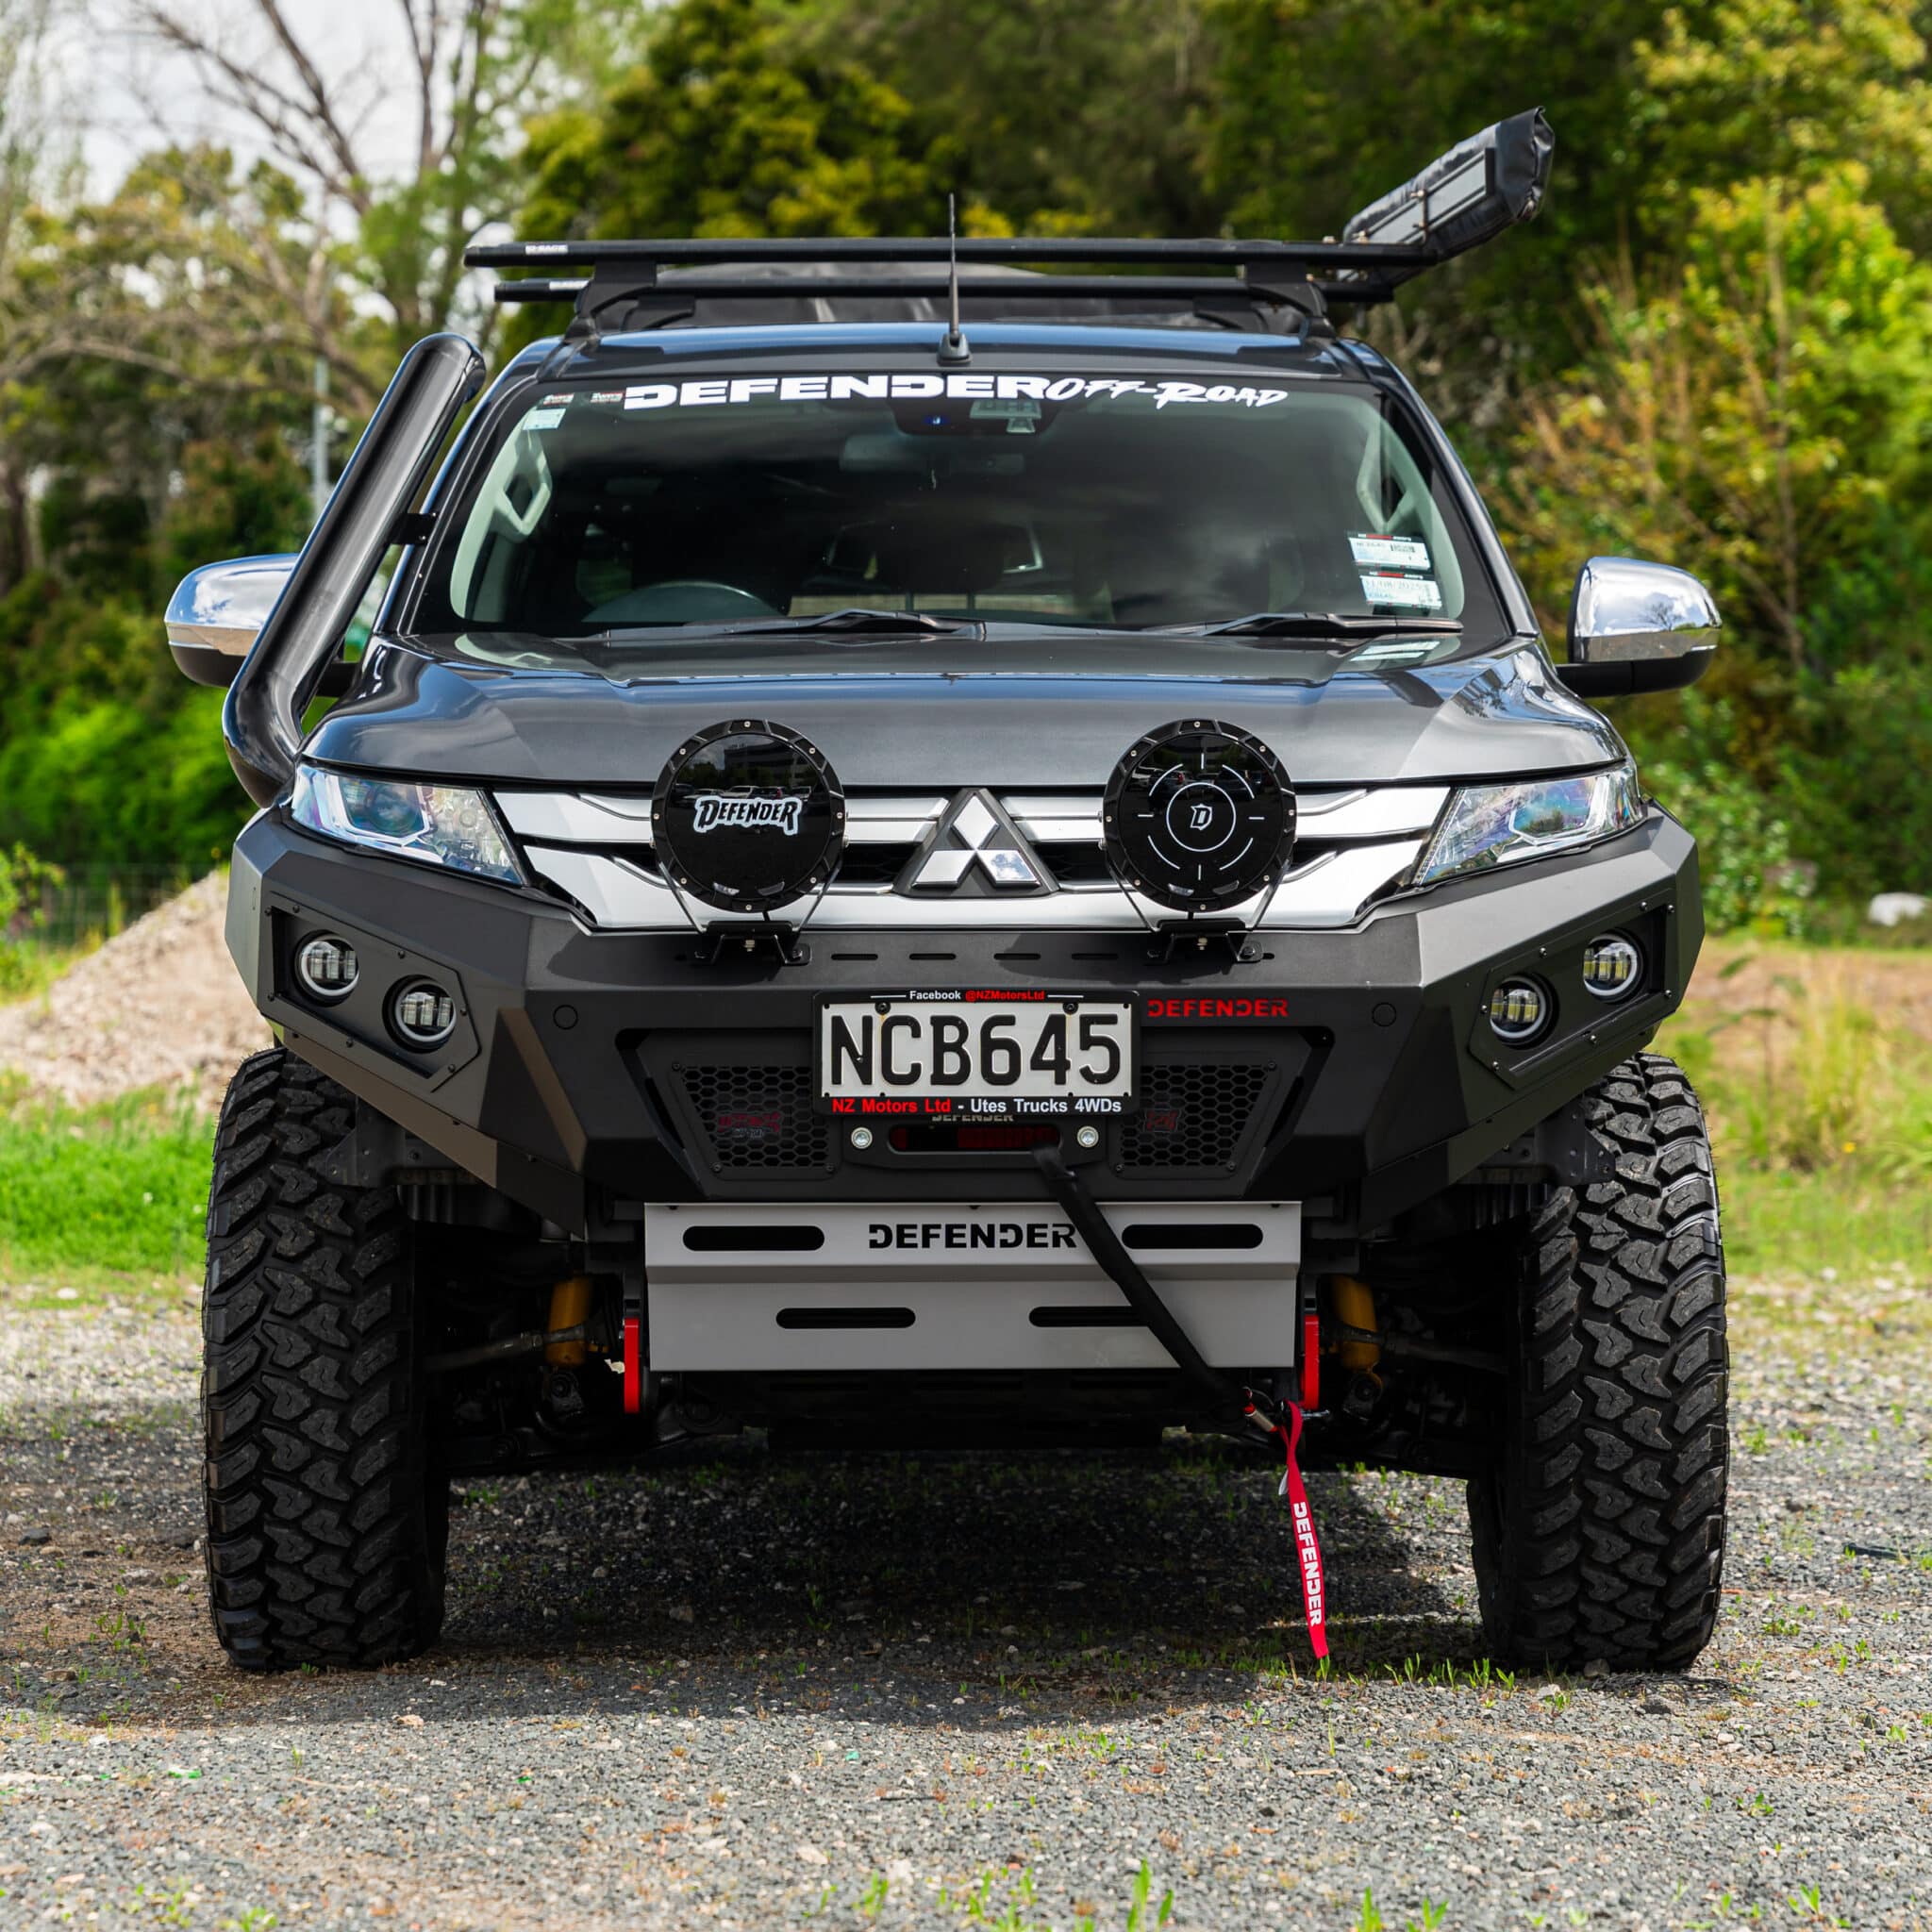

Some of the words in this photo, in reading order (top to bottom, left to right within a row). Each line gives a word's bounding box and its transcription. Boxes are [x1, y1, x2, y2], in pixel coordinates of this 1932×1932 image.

[694, 796, 801, 835] DEFENDER
[1190, 803, 1213, 831] D
[909, 991, 961, 1000] Facebook
[965, 991, 1045, 1001] @NZMotorsLtd
[1147, 998, 1290, 1018] DEFENDER
[830, 1013, 1122, 1086] NCB645
[832, 1098, 856, 1113] NZ
[861, 1098, 919, 1113] Motors
[924, 1098, 951, 1113] Ltd
[971, 1098, 1007, 1113] Utes
[1013, 1098, 1068, 1113] Trucks
[1074, 1098, 1123, 1113] 4WDs
[869, 1223, 1077, 1249] DEFENDER
[1293, 1501, 1323, 1627] DEFENDER
